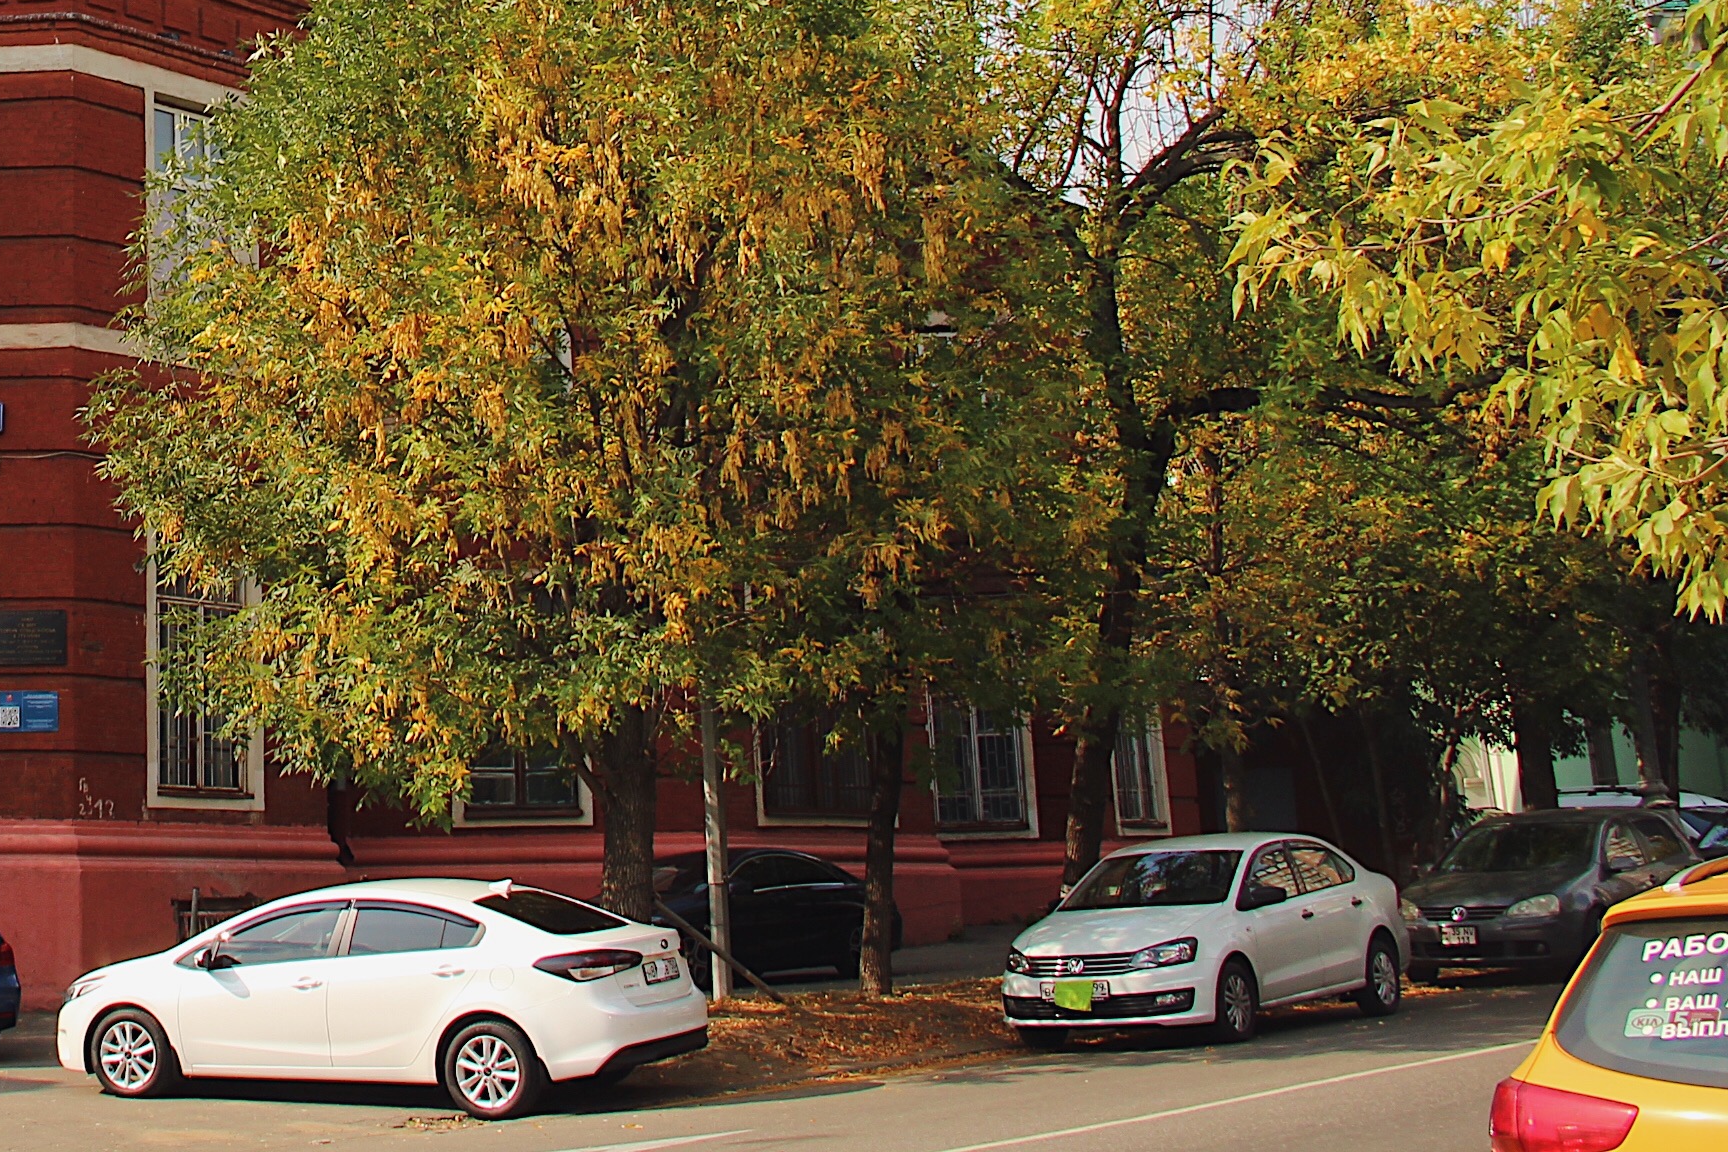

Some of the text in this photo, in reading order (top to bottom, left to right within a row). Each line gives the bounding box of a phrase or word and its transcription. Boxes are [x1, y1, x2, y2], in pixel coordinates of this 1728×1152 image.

[1668, 967, 1723, 986] НАШ
[1665, 993, 1719, 1012] ВАШ
[1636, 1018, 1659, 1026] KIA
